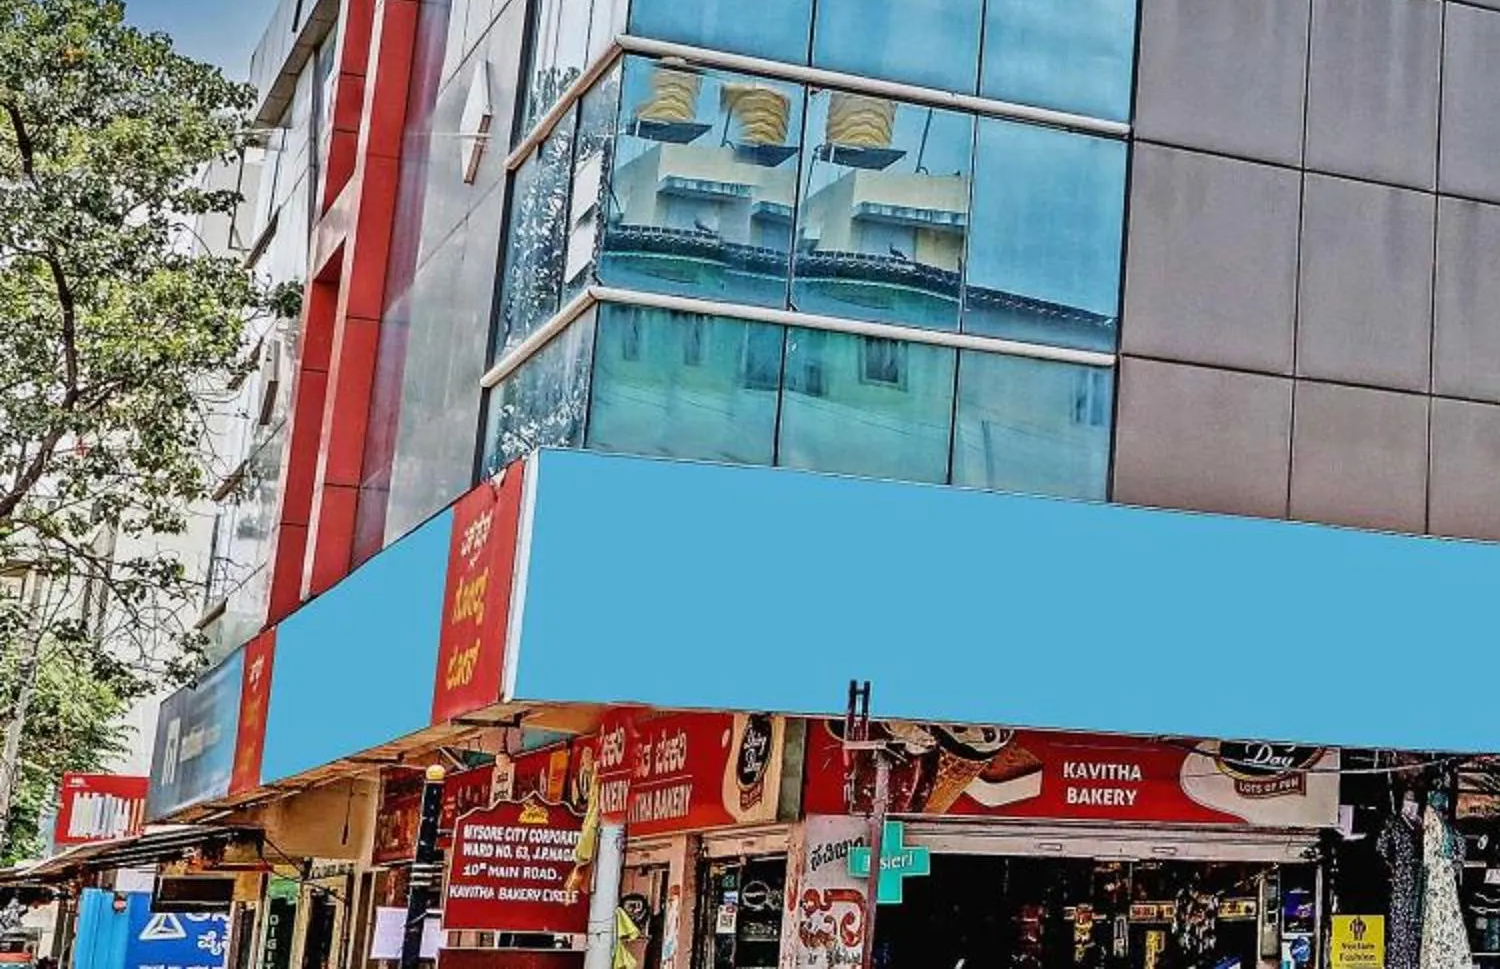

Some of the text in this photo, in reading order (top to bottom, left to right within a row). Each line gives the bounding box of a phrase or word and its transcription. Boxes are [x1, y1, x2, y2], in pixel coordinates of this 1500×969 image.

[1242, 741, 1295, 769] Day
[1063, 760, 1143, 783] KAVITHA
[653, 783, 693, 821] BAKERY
[1066, 786, 1138, 807] BAKERY
[463, 824, 581, 845] MYSORE CITY CORPORAT
[463, 842, 493, 857] WARD
[495, 844, 513, 859] NO.
[515, 846, 531, 862] 63,
[487, 866, 519, 879] MAIN
[449, 884, 495, 899] KAVITHA
[498, 887, 541, 901] BAKERY
